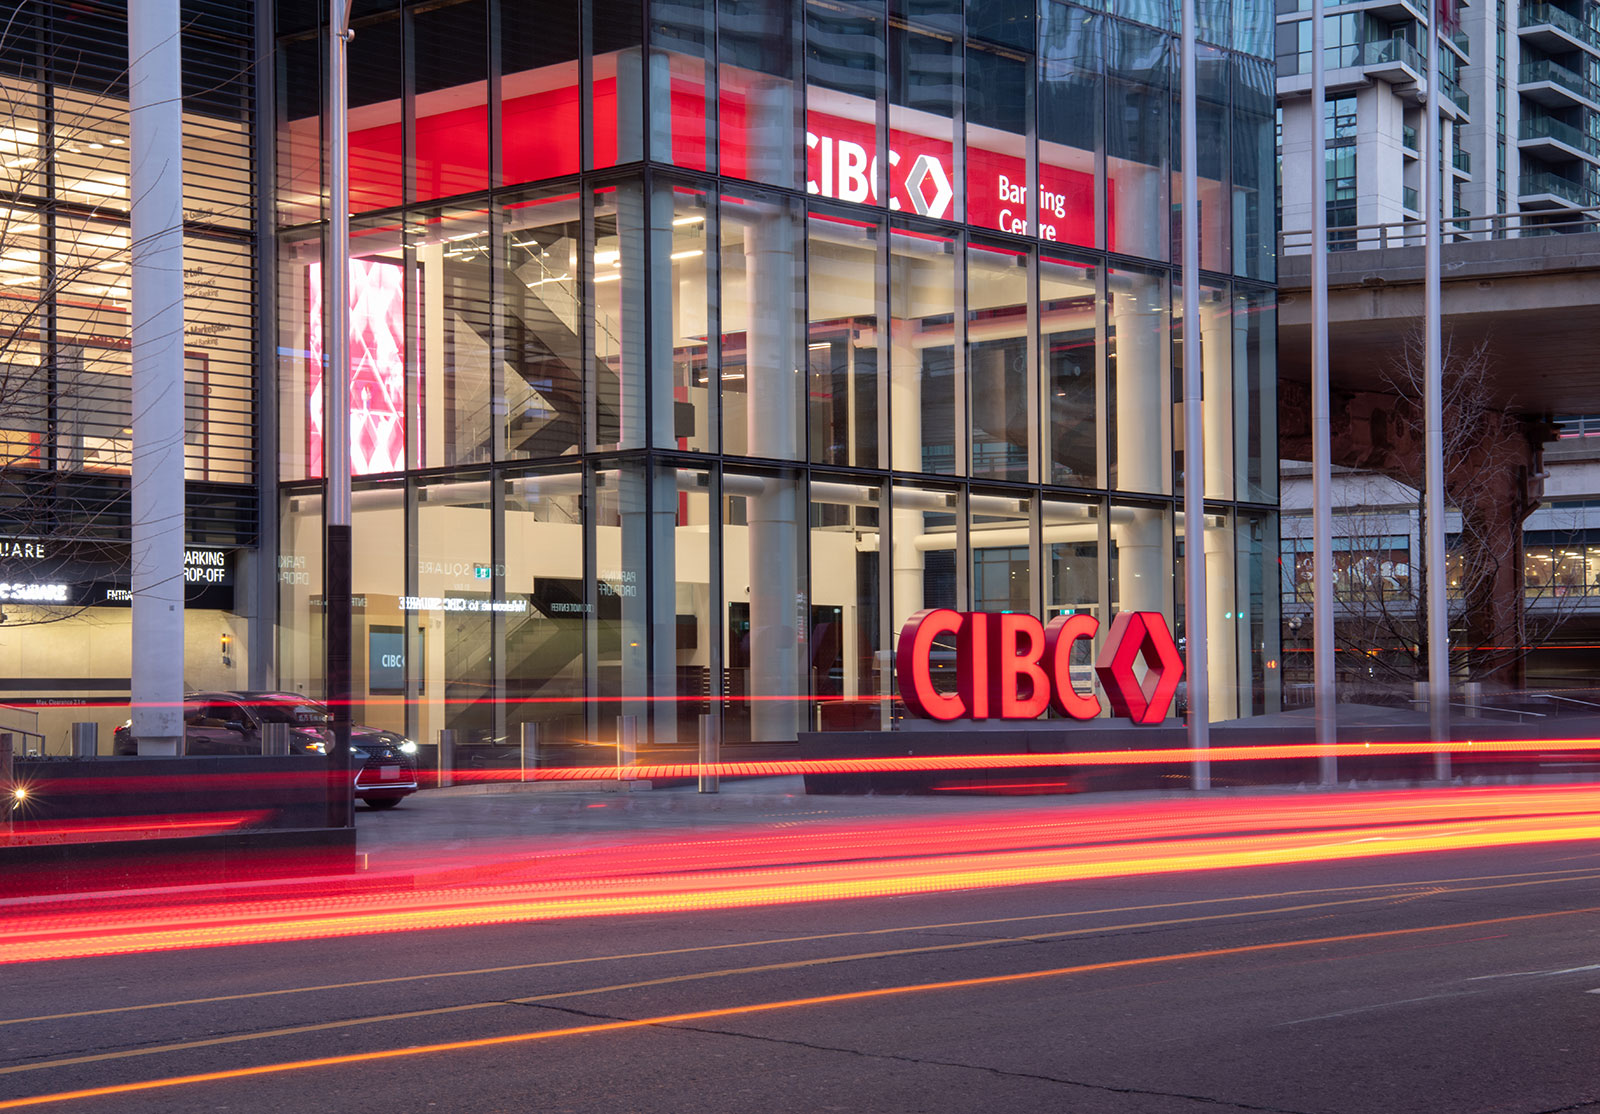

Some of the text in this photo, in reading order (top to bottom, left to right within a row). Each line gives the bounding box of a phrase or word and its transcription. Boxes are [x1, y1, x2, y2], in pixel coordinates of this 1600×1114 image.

[183, 551, 225, 566] ARKING
[382, 654, 402, 668] CIBC
[897, 608, 1102, 721] CIBC
